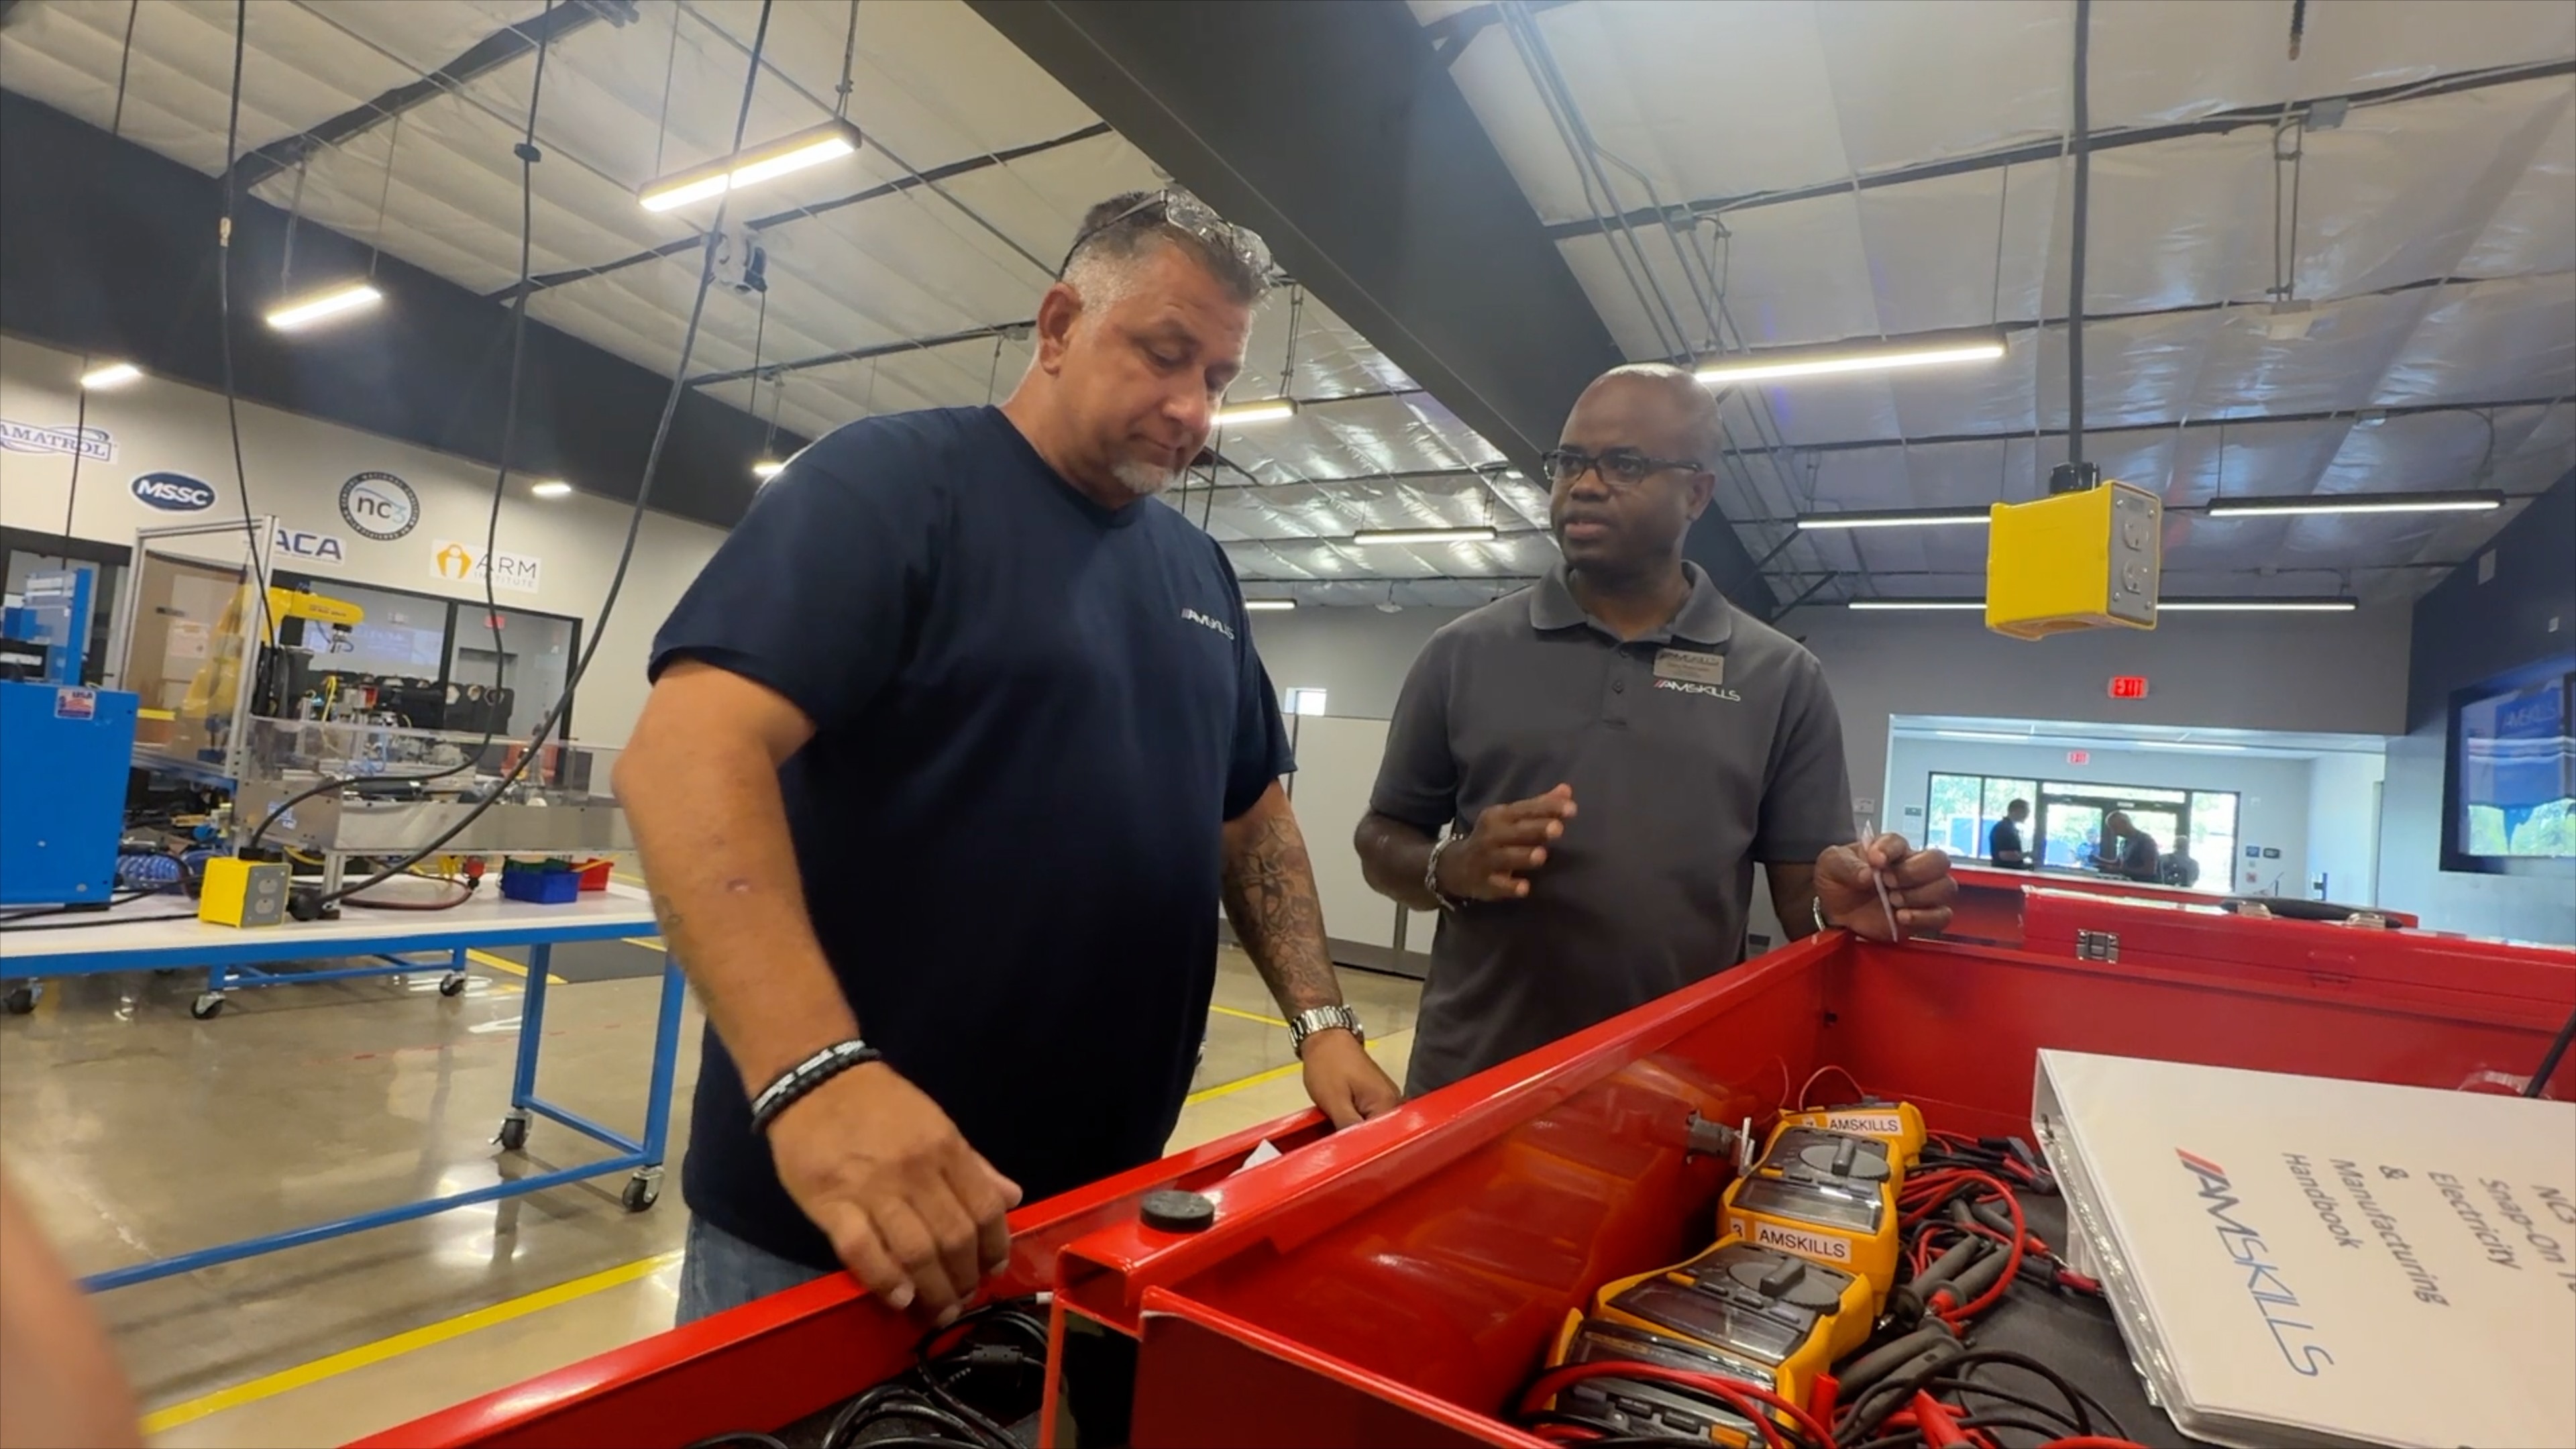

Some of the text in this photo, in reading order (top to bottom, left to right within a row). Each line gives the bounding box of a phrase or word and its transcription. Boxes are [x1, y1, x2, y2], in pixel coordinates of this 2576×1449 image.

[0, 424, 105, 457] AMATROL
[137, 478, 209, 506] MSSC
[272, 529, 342, 560] ACA
[474, 571, 535, 588] INTITUTE
[476, 553, 537, 579] ARM
[1654, 679, 1741, 702] AMSKILLS
[2114, 678, 2143, 697] EXIT
[1829, 1118, 1898, 1132] AMSKILLS
[2378, 1165, 2410, 1181] &
[2281, 1152, 2365, 1250] Handbook
[2328, 1158, 2451, 1307] Manufacturing
[2427, 1171, 2523, 1271] Electricity
[2477, 1177, 2567, 1265] Snap-On
[1759, 1228, 1845, 1258] AMSKILLS
[2176, 1146, 2334, 1377] AMSKILLS
